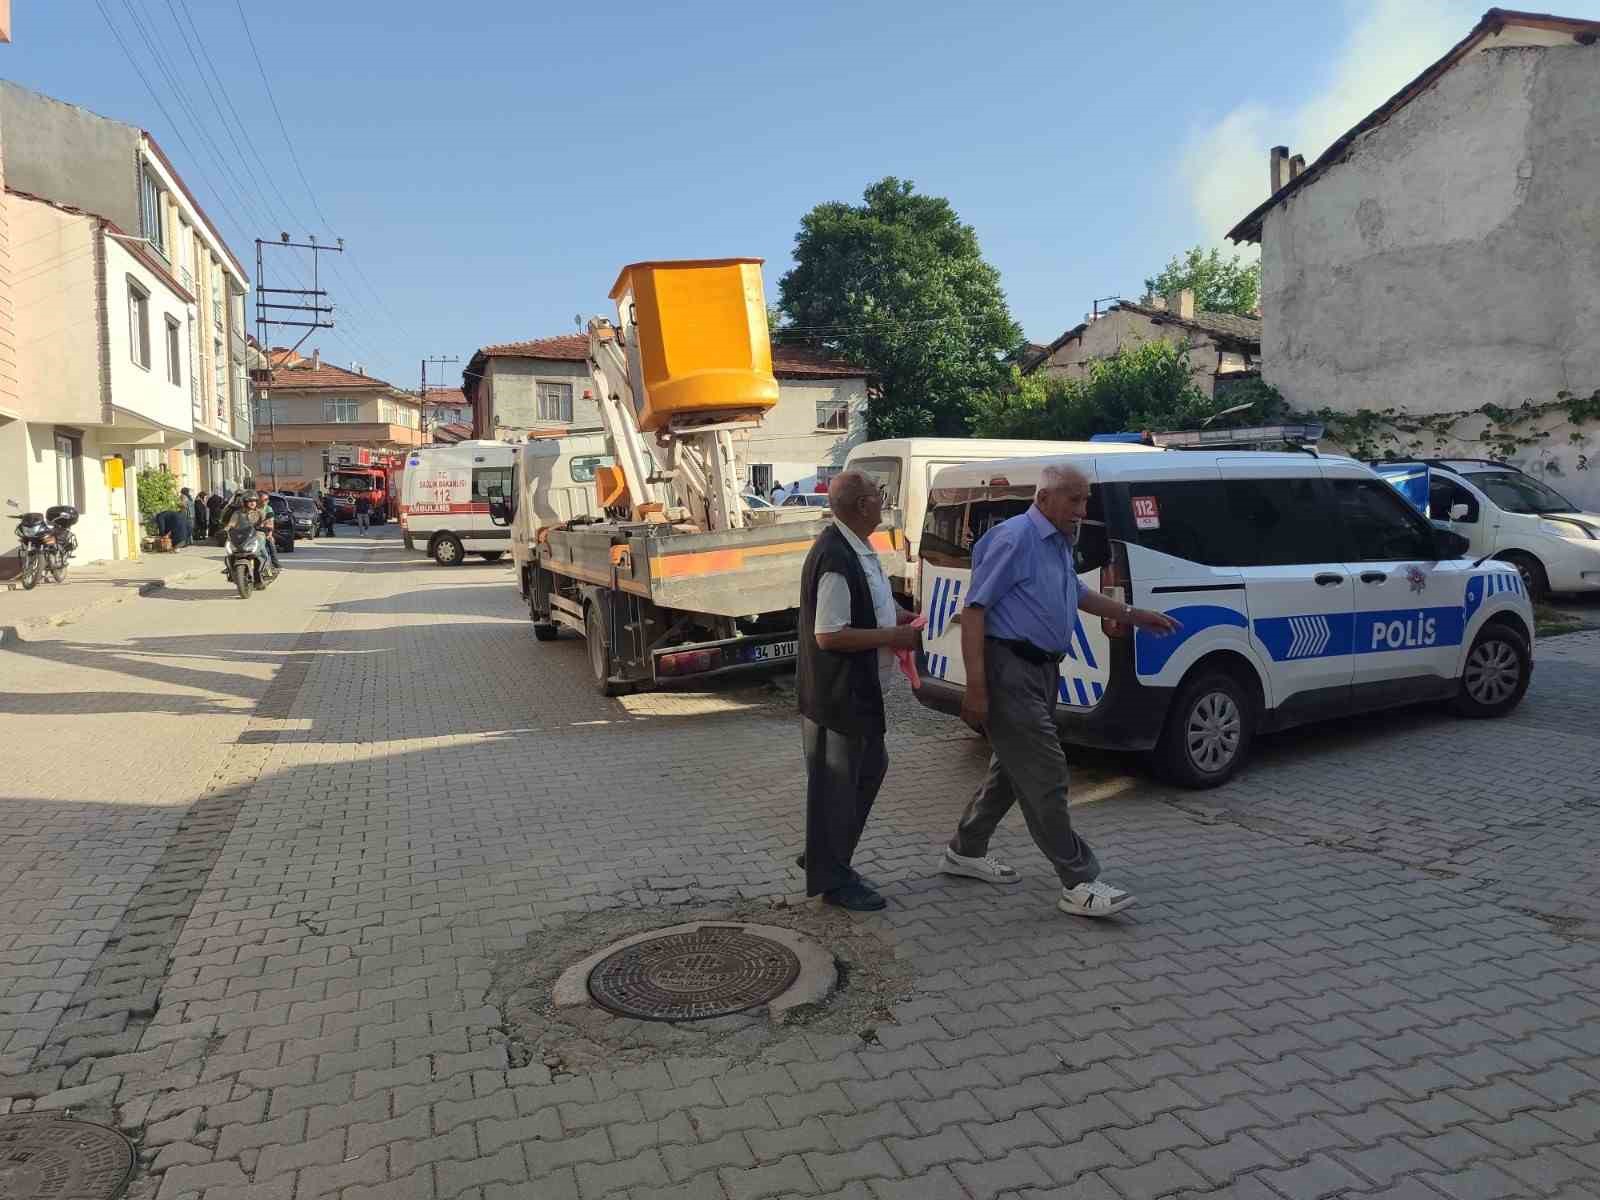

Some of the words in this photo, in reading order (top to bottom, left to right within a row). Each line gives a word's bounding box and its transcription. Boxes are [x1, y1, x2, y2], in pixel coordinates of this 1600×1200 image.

[434, 489, 451, 502] 112
[1135, 500, 1154, 516] 112
[1371, 612, 1436, 649] POLİS
[755, 646, 769, 659] 34
[774, 642, 794, 657] BYU
